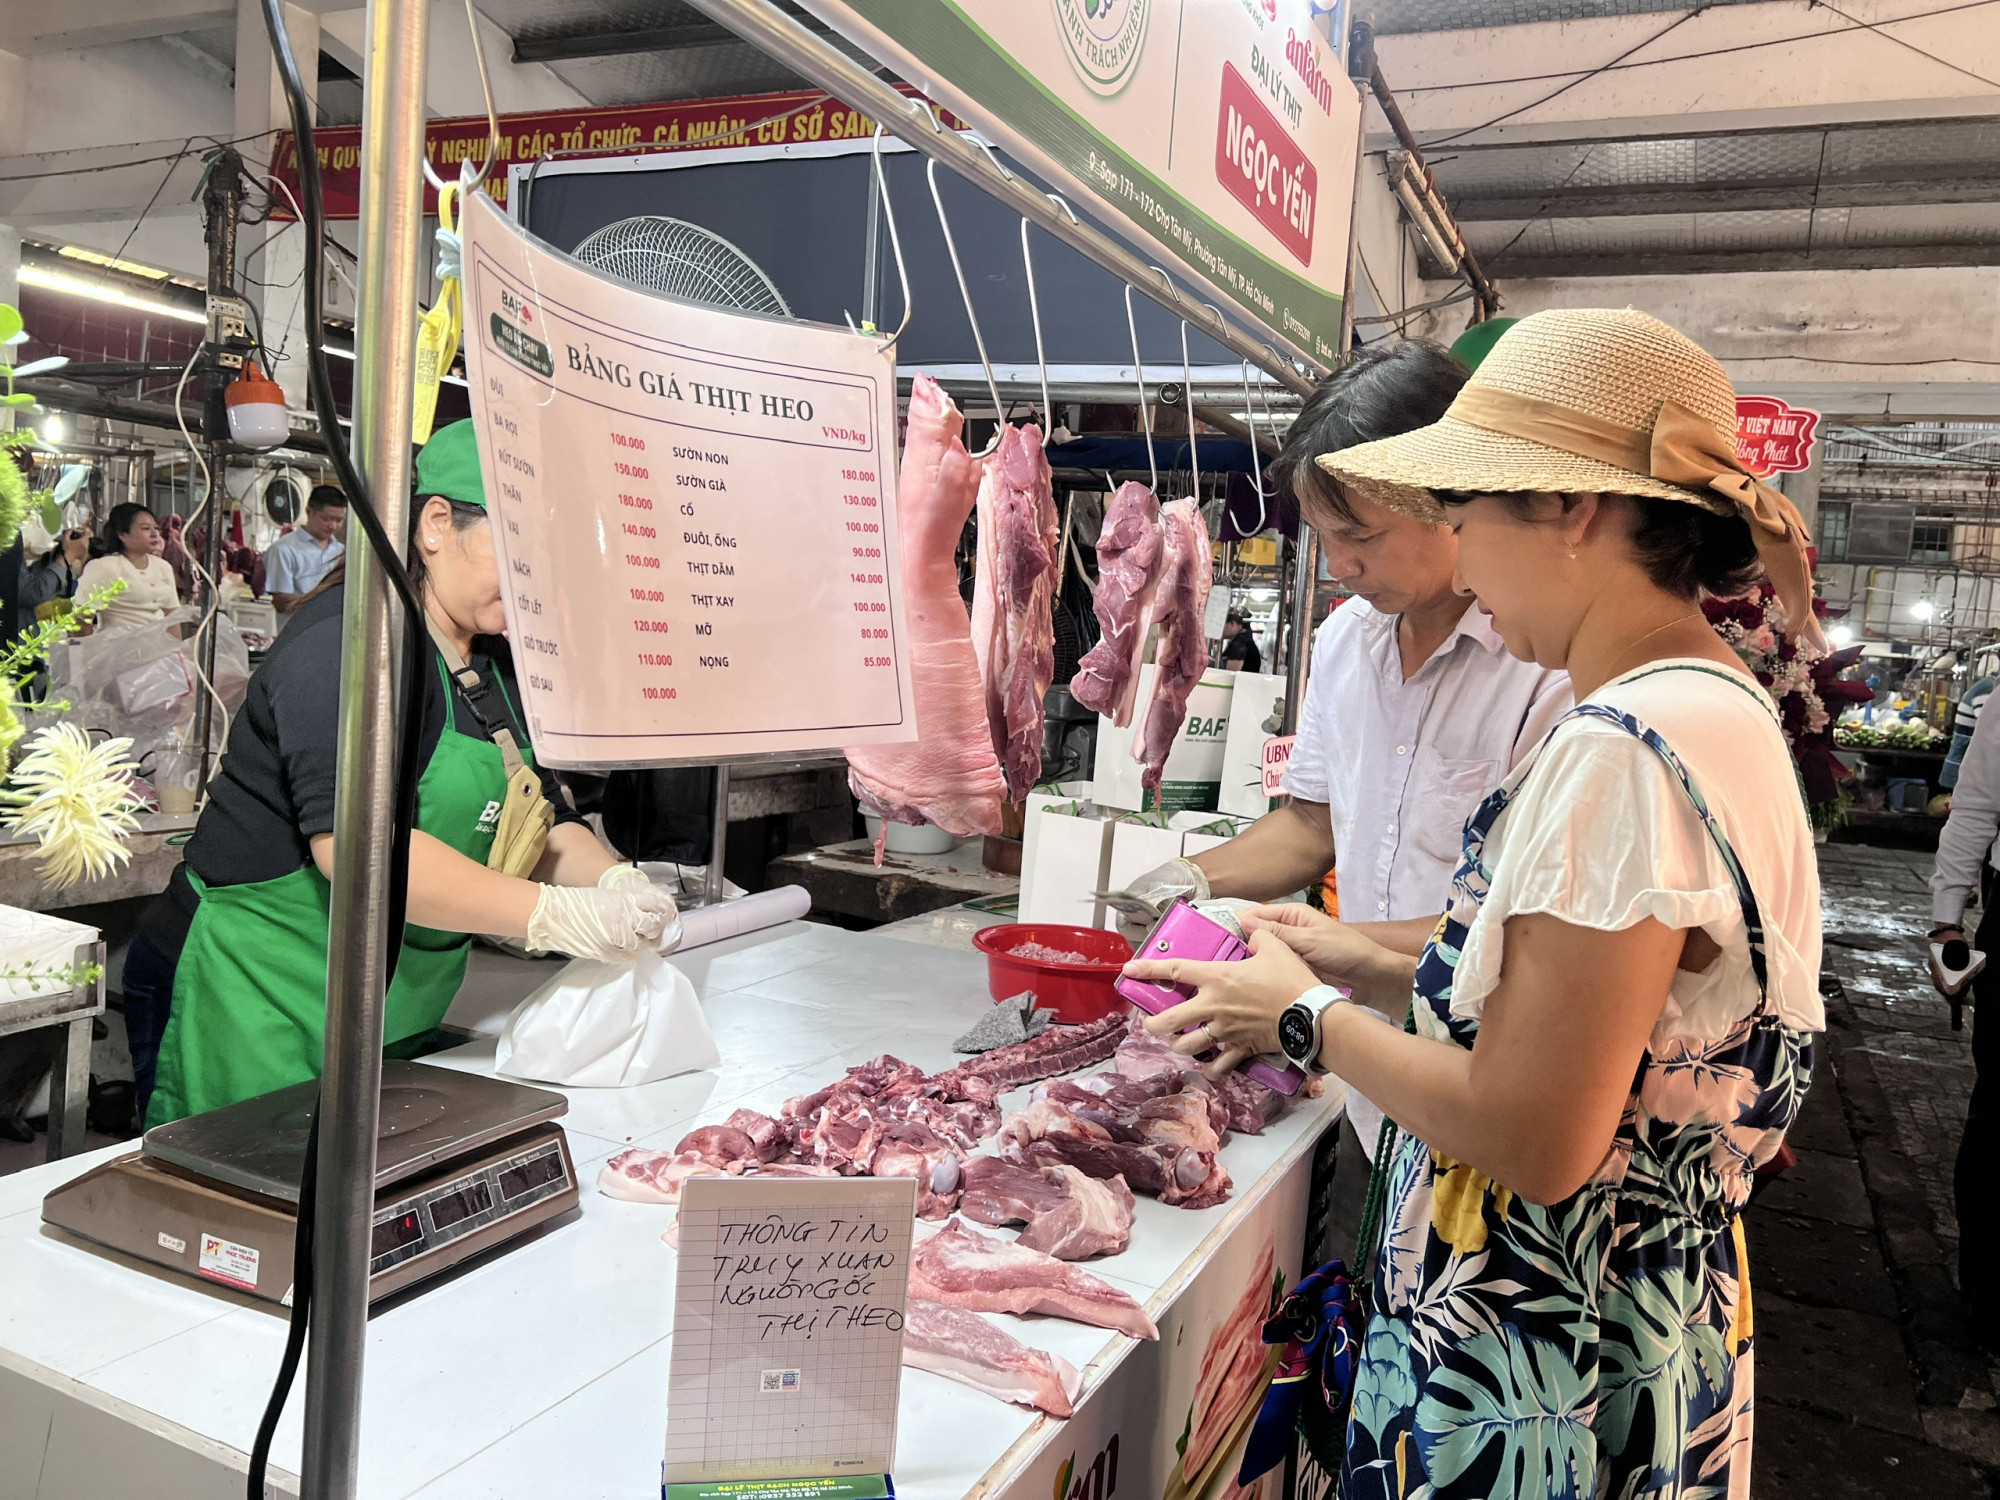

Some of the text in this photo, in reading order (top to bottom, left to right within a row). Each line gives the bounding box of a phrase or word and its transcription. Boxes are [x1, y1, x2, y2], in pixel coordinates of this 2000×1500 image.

[1085, 37, 1118, 68] TRÁCH
[1286, 27, 1332, 118] anfarm
[1251, 43, 1303, 130] ĐẠI LÝ THỊT
[518, 130, 554, 159] CÁC
[561, 121, 586, 156] TỔ
[590, 122, 646, 154] CHỨC,
[654, 118, 682, 149] CÁ
[687, 115, 750, 147] NHÂN,
[794, 105, 824, 140] SỞ
[1226, 104, 1312, 240] NGỌC YẾN
[1100, 160, 1117, 191] Sạp
[1120, 174, 1134, 201] 171
[1140, 190, 1155, 217] 172
[1155, 203, 1170, 234] Chợ
[1170, 215, 1181, 240] Tân
[1194, 238, 1216, 274] Phường
[1217, 256, 1227, 279] Tân
[490, 377, 504, 397] ĐÙI
[566, 343, 631, 388] BẢNG
[639, 371, 684, 401] GIÁ
[688, 381, 752, 416] THỊT
[760, 394, 814, 422] HEO
[494, 412, 518, 437] BA RỌI
[1746, 414, 1771, 437] VIỆT
[1771, 419, 1797, 436] NAM
[611, 433, 645, 451] 100.000
[822, 426, 866, 445] VND/kg
[672, 446, 729, 465] SƯỜN NON
[1762, 439, 1790, 462] Phát
[498, 449, 535, 478] RÚT SƯỜN
[614, 462, 648, 480] 150.000
[676, 474, 727, 492] SƯỜN GIÀ
[841, 469, 875, 482] 180.000
[618, 493, 653, 511] 180.000
[843, 495, 877, 507] 130.000
[507, 519, 520, 536] VAI
[622, 523, 656, 539] 140.000
[845, 521, 879, 533] 100.000
[683, 532, 737, 548] ĐUÔI, ỐNG
[626, 554, 660, 569] 100.000
[852, 547, 881, 558] 90.000
[513, 557, 532, 578] NÁCH
[687, 561, 709, 577] THỊT
[850, 573, 883, 584] 140.000
[630, 588, 665, 602] 100.000
[691, 594, 735, 609] THỊT XAY
[853, 602, 886, 612] 100.000
[634, 620, 668, 634] 120.000
[695, 622, 713, 636] MỠ
[861, 628, 889, 639] 80.000
[524, 634, 558, 656] GIÒ TRƯỚC
[638, 653, 673, 666] 110.000
[699, 656, 730, 670] NỌNG
[863, 656, 891, 667] 85.000
[541, 678, 553, 692] SAU
[642, 687, 677, 700] 100.000
[1186, 716, 1226, 737] BAF
[1266, 743, 1293, 764] UBN
[720, 1215, 819, 1246] THÔNG
[713, 1253, 803, 1286] TRUY
[746, 1483, 765, 1491] THỊT
